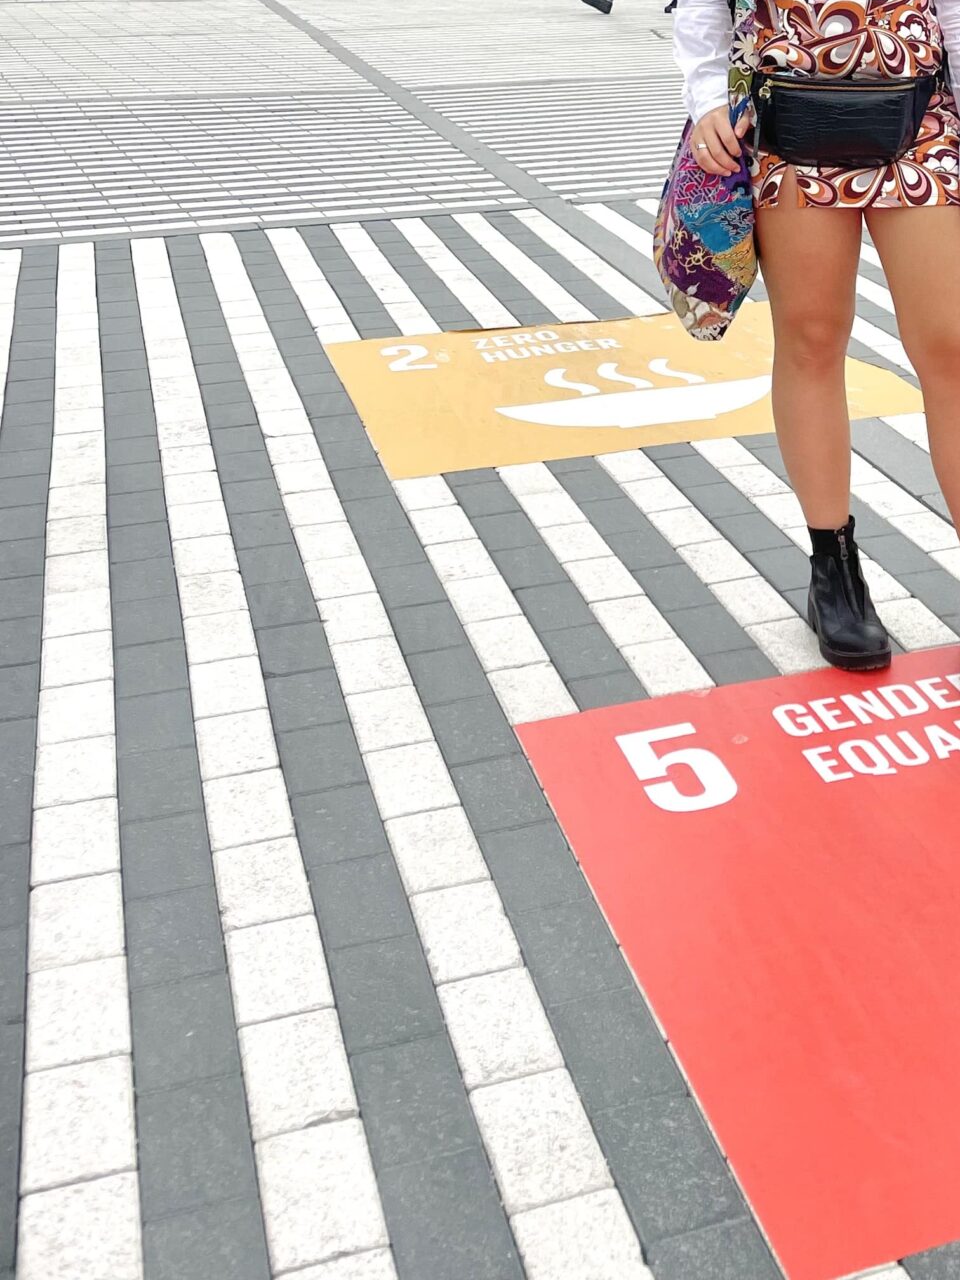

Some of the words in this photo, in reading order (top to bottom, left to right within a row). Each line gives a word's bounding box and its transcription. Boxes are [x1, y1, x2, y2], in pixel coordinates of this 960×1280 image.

[472, 330, 560, 350] ZERO
[481, 338, 623, 363] HUNGER
[379, 344, 438, 372] 2
[614, 722, 738, 812] 5
